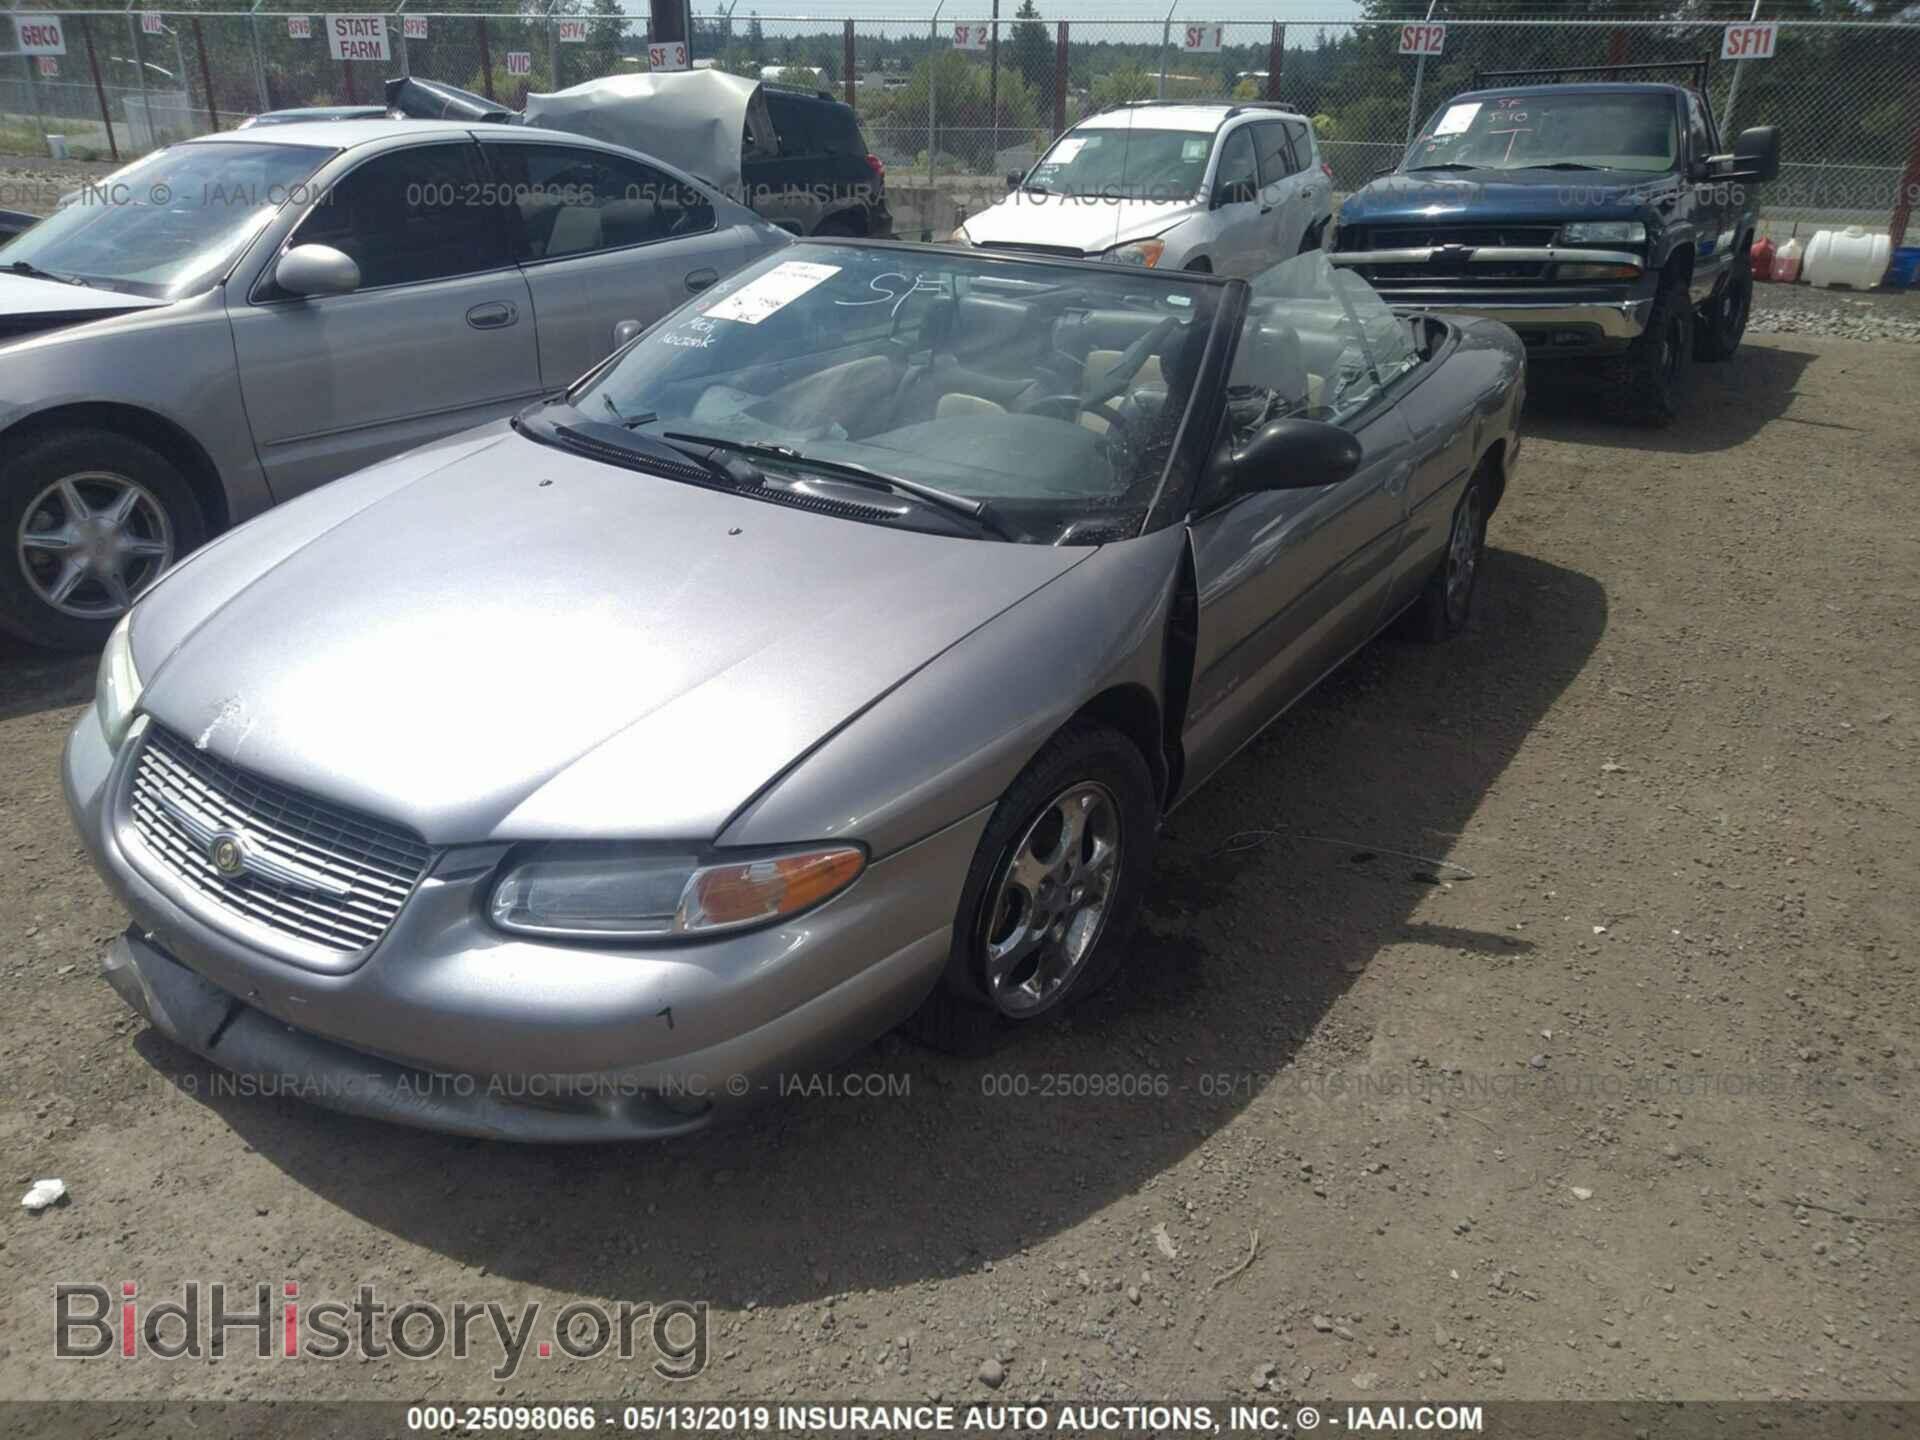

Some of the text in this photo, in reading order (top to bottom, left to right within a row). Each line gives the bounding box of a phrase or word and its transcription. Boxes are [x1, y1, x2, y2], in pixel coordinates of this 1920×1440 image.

[22, 24, 61, 47] GEICO
[335, 18, 381, 36] STATE
[560, 23, 586, 39] SFV4
[955, 26, 987, 45] SF 2
[1186, 27, 1222, 48] SF 1
[1402, 25, 1443, 52] SF12
[1727, 27, 1772, 56] SF11
[340, 41, 382, 59] FARM
[651, 46, 685, 66] SF 3
[509, 55, 530, 73] VIC
